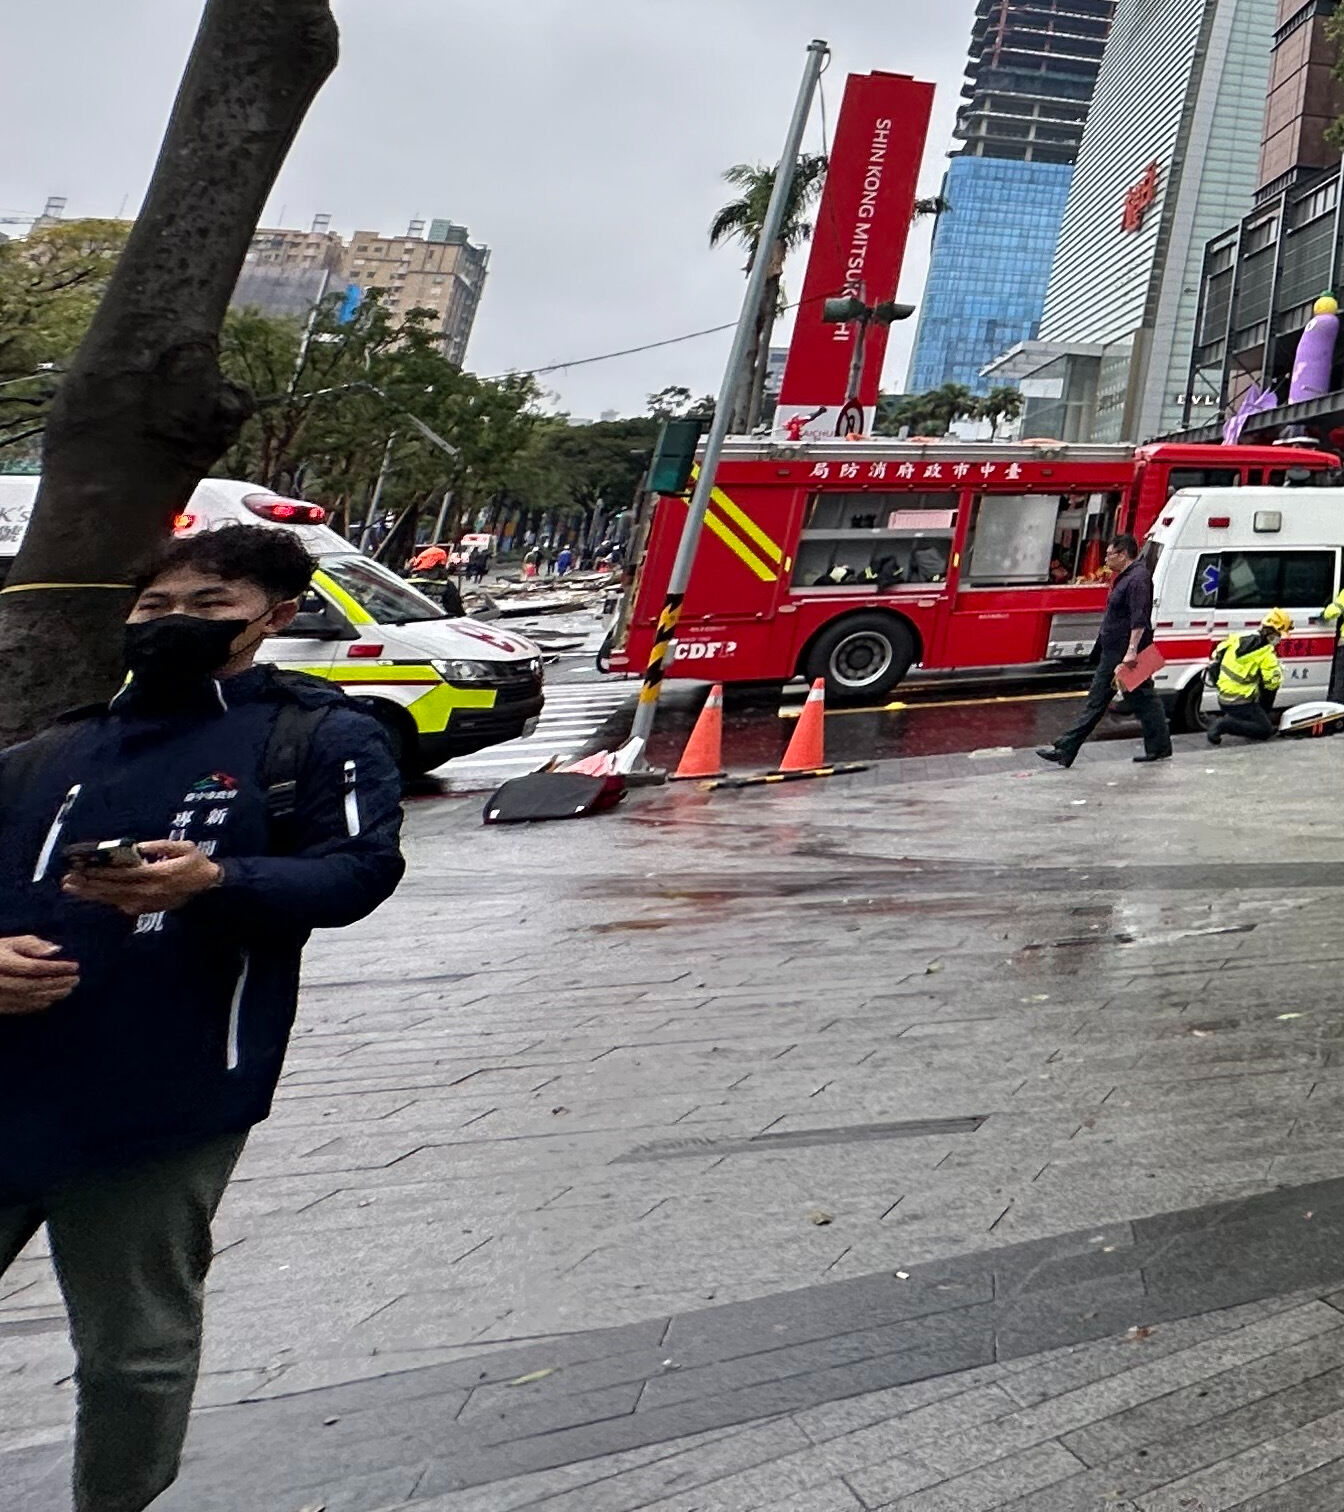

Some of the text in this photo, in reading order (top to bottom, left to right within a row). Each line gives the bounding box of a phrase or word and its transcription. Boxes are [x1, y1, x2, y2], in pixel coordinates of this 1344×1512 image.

[832, 117, 892, 341] SHIN KONG MITSUKHI
